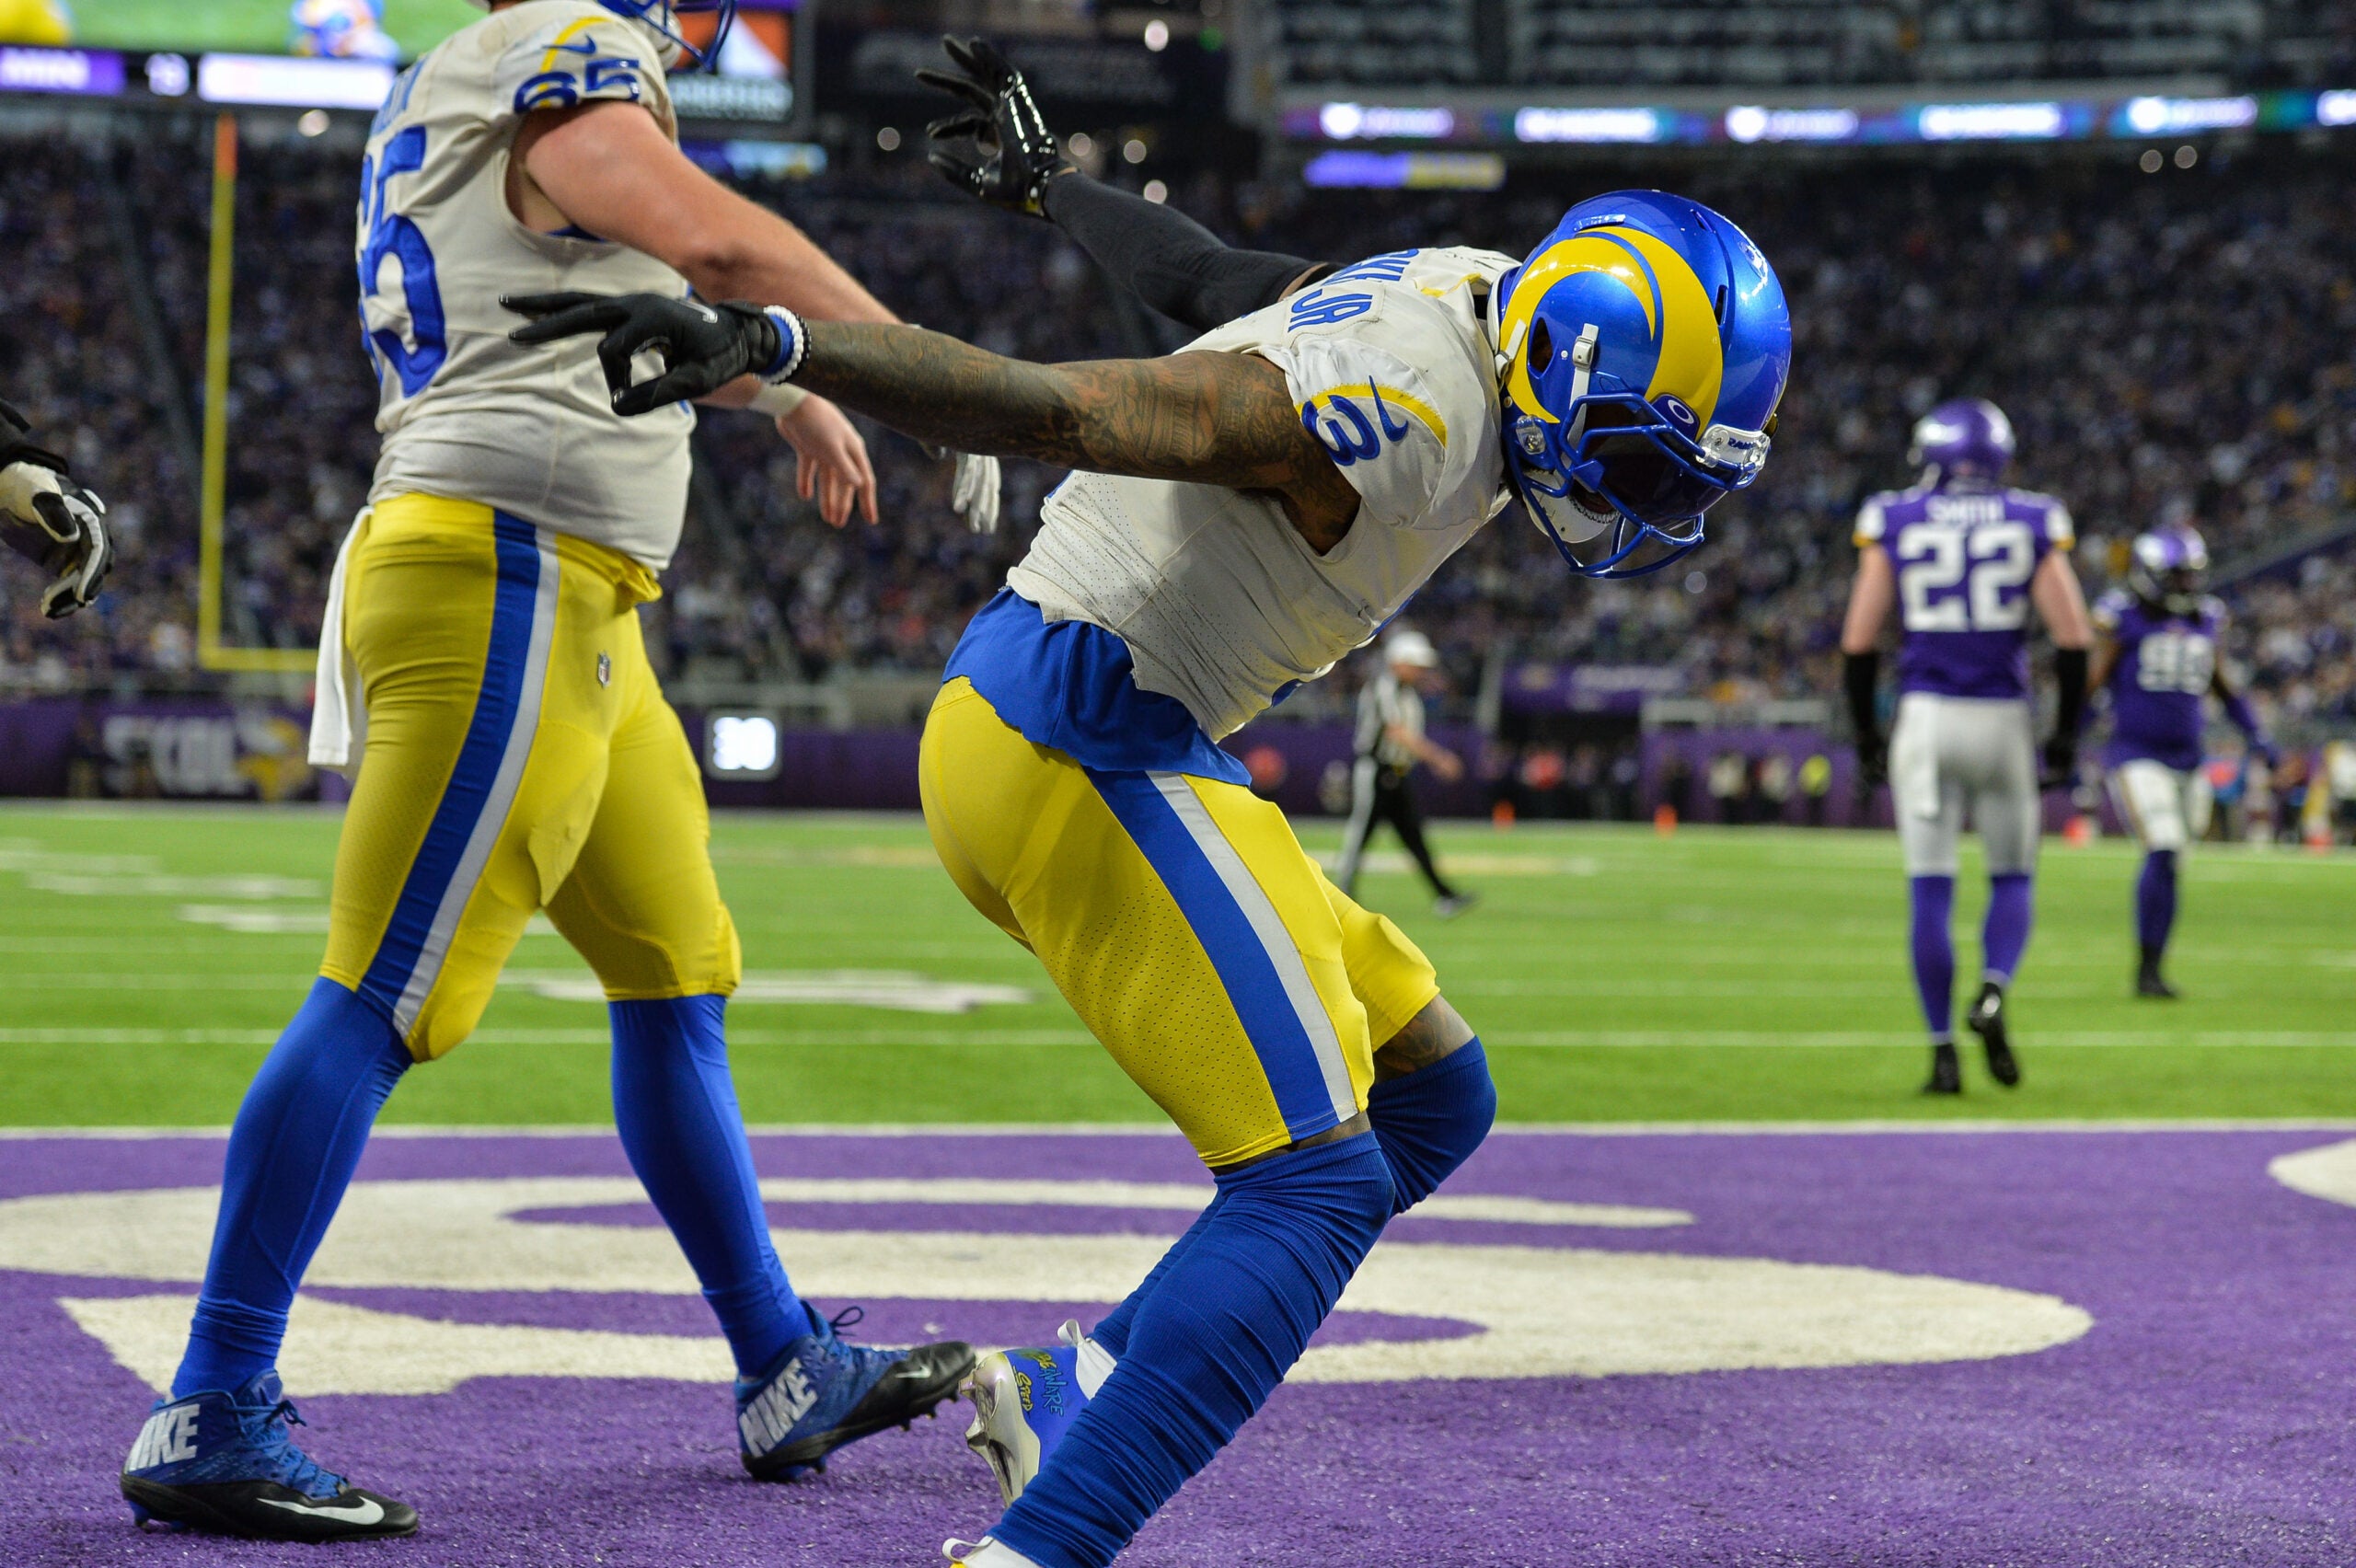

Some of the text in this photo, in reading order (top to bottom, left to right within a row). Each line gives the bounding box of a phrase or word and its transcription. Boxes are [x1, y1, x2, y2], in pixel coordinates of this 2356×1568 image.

[514, 59, 640, 114] 65
[1288, 288, 1373, 333] JR
[1301, 395, 1380, 467] 3
[1925, 495, 2005, 523] SMITH
[1898, 521, 2035, 632] 22
[738, 1356, 818, 1458] NIKE
